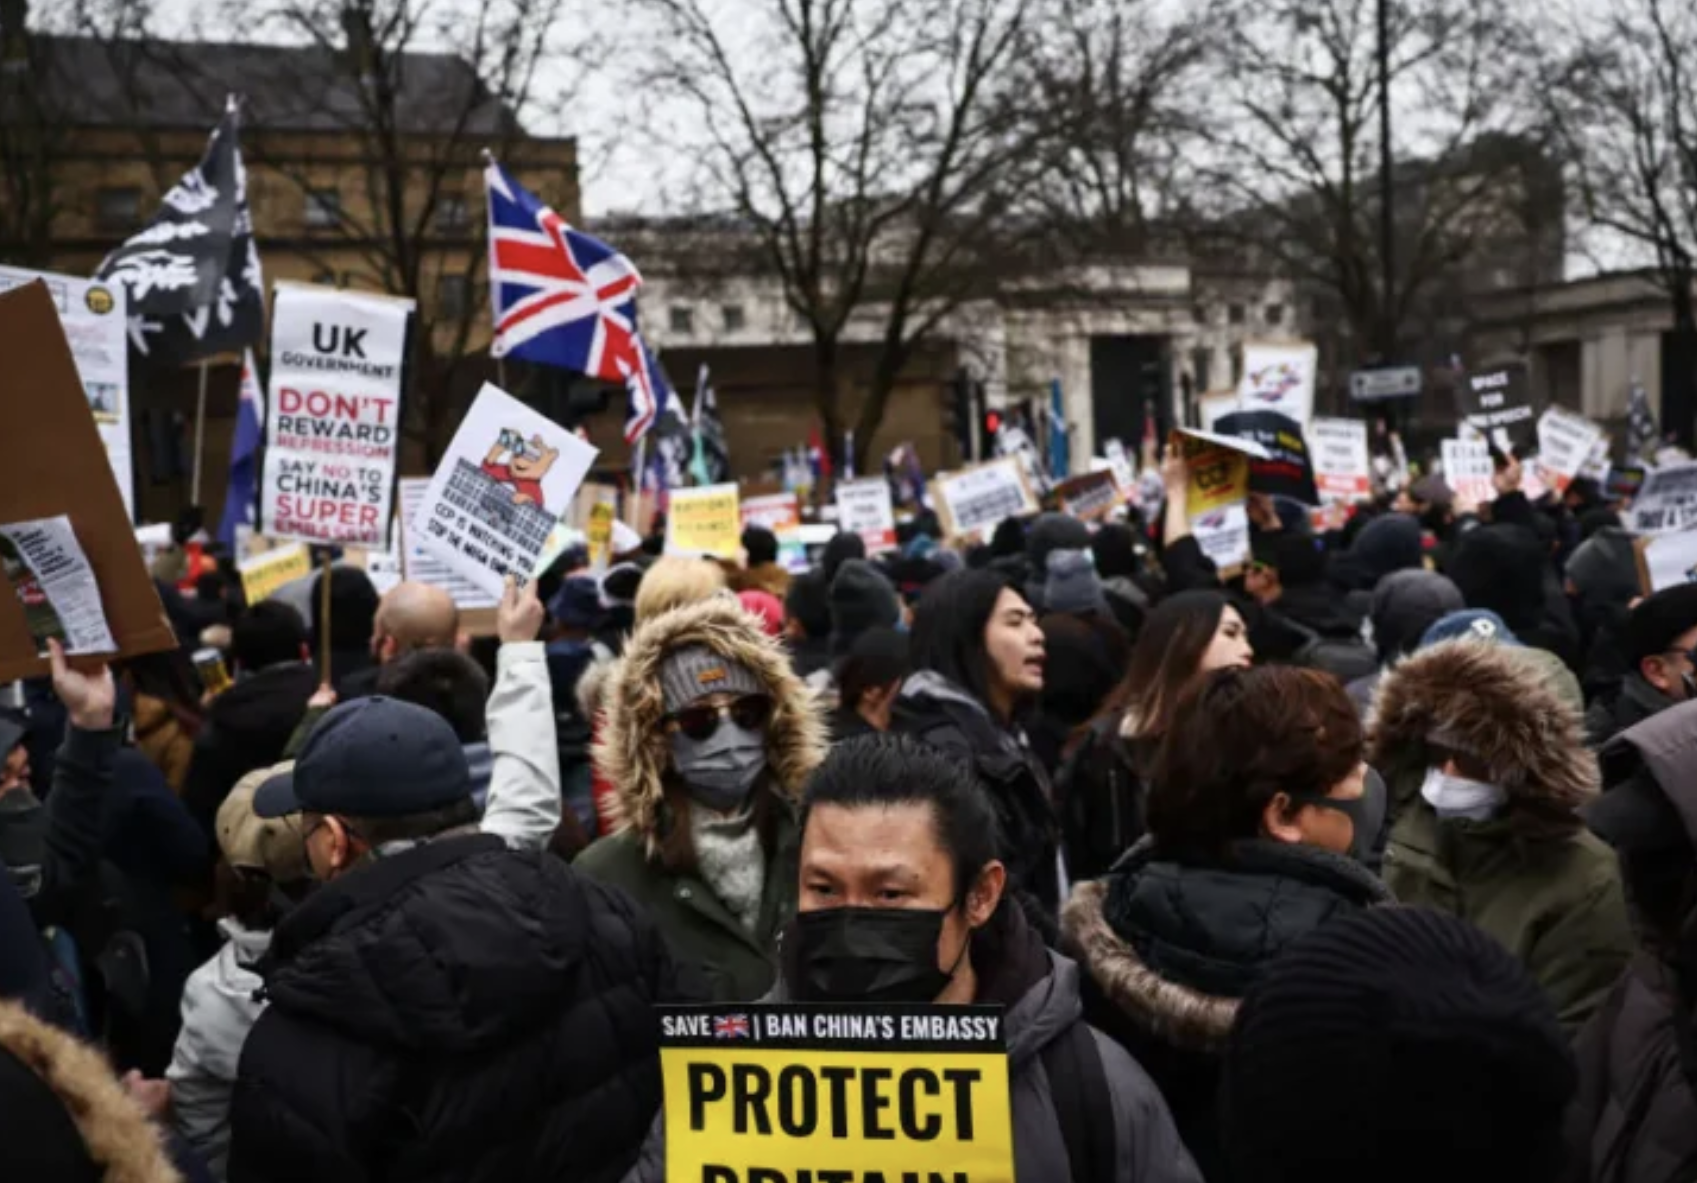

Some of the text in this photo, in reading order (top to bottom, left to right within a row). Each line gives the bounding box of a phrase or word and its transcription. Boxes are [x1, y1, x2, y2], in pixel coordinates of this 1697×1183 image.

[313, 321, 368, 359] UK
[281, 351, 394, 378] GOVERNMENT
[278, 387, 393, 424] DON'T
[278, 415, 391, 444] REWARD
[277, 432, 390, 459] REPRESSION
[279, 458, 382, 484] SAY NO TO
[276, 473, 382, 504] CHINA'S
[276, 493, 379, 528] SUPER
[662, 1014, 711, 1036] SAVE
[766, 1014, 806, 1038] BAN
[813, 1014, 895, 1039] CHINA'S
[900, 1015, 998, 1041] EMBASSY
[687, 1062, 981, 1142] PROTECT
